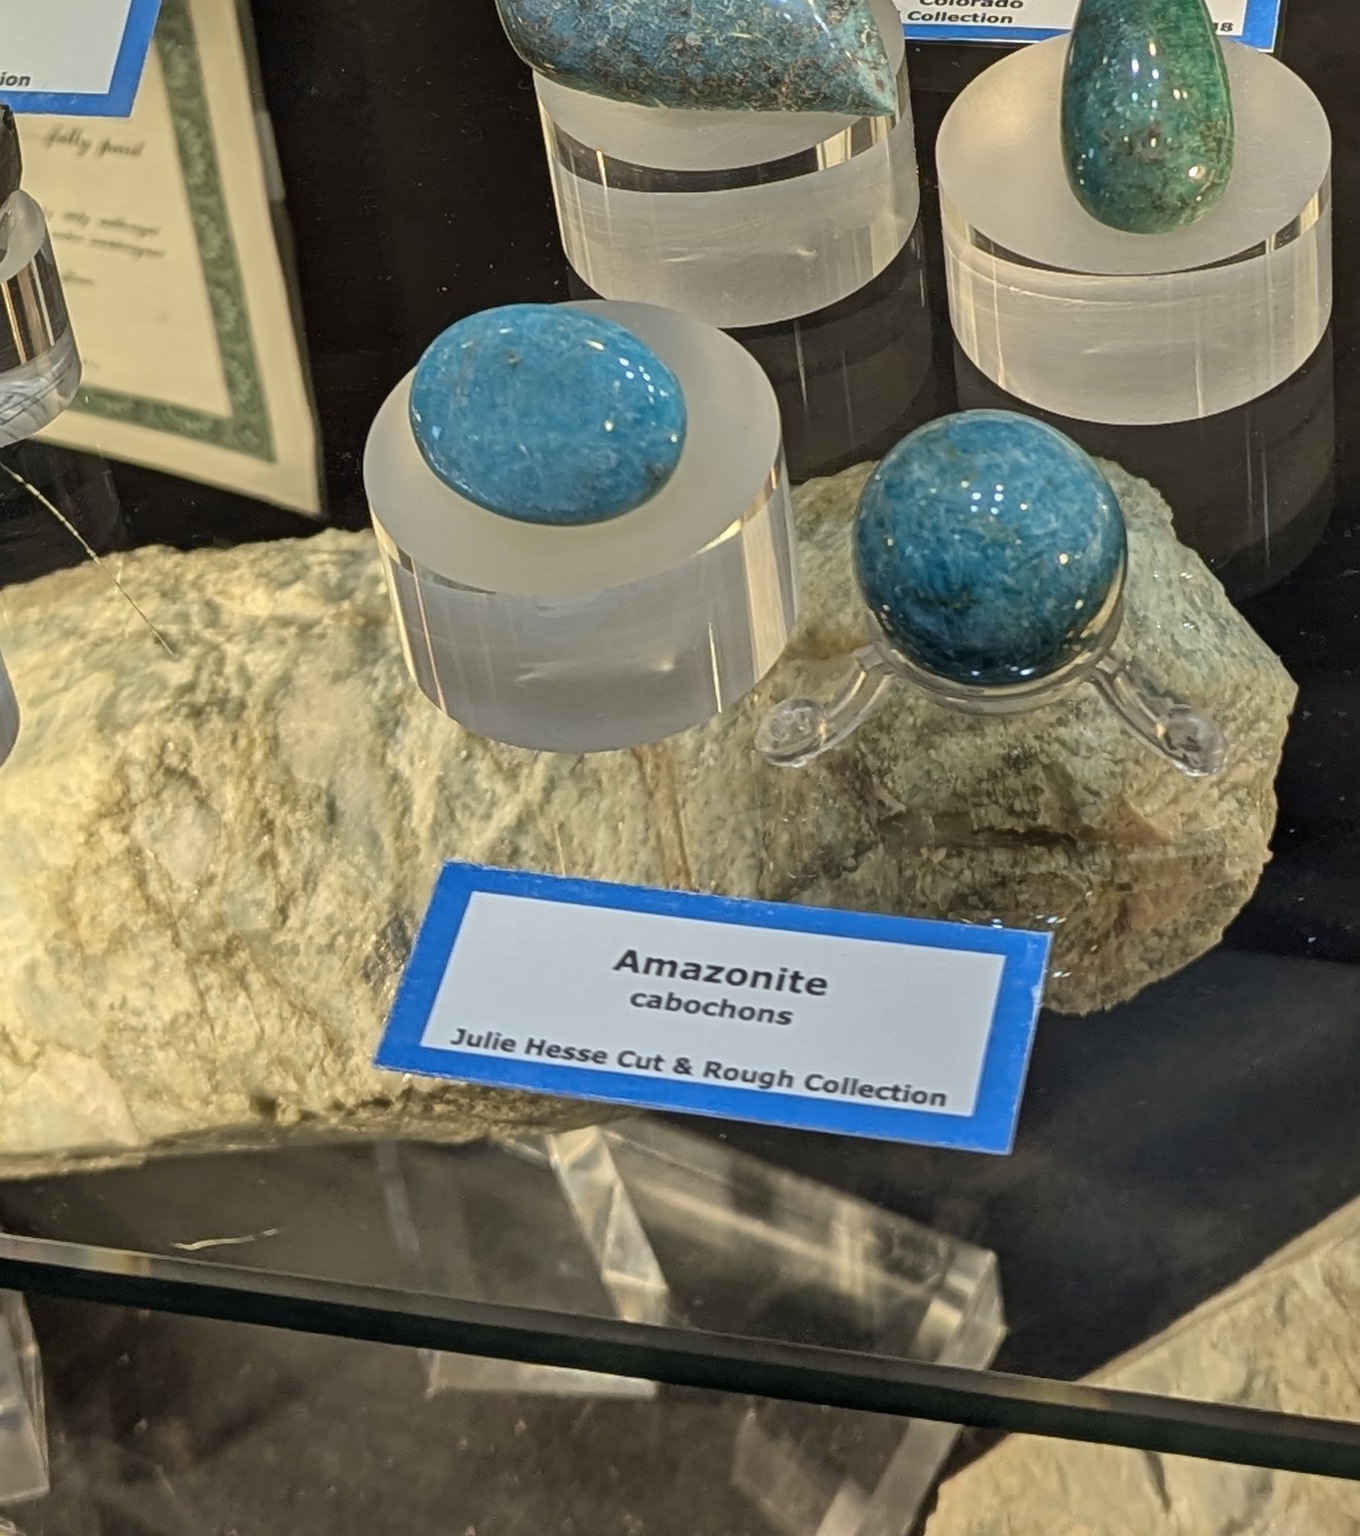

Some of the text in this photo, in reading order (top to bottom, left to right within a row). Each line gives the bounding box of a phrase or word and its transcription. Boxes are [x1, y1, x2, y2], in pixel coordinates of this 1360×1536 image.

[908, 9, 1013, 25] Collection
[612, 948, 829, 997] Amazonite
[630, 989, 793, 1025] cabochons
[450, 1028, 947, 1107] Julie Hesse Cut & Rough Collection
